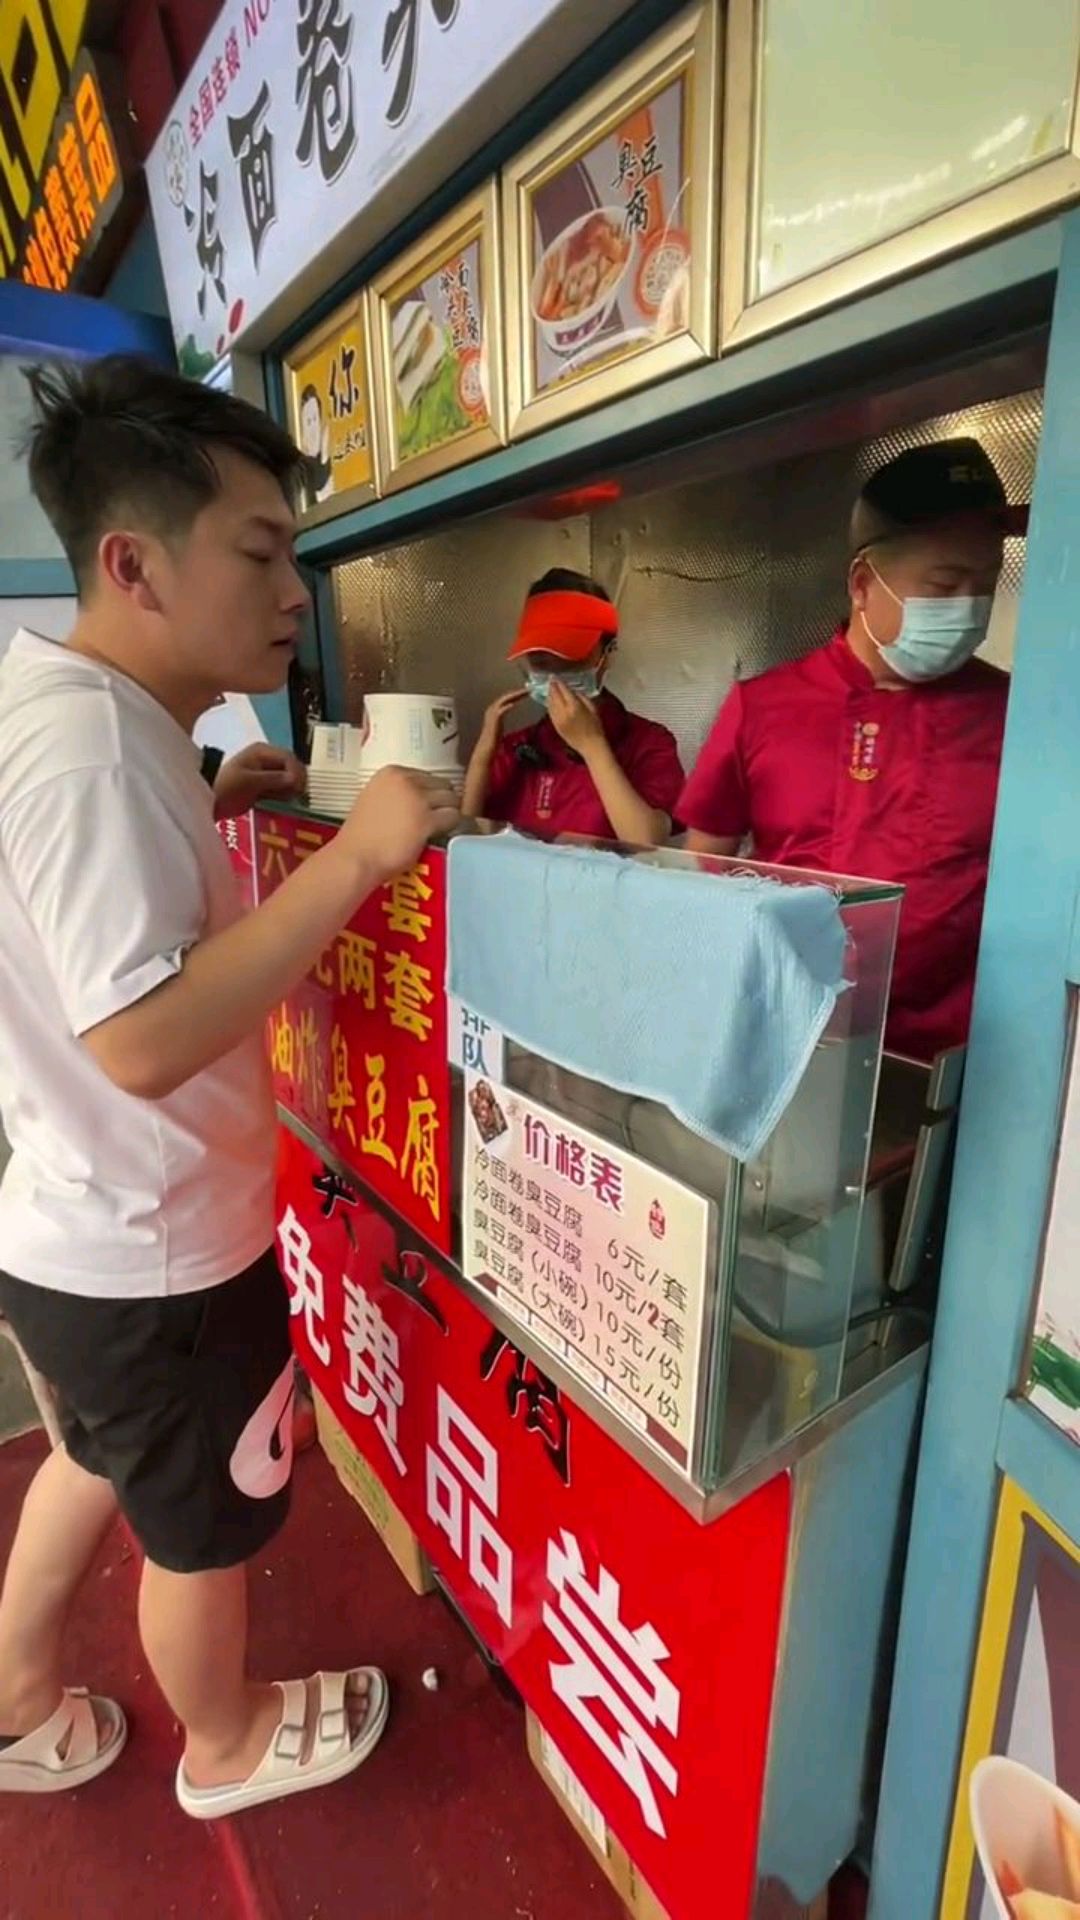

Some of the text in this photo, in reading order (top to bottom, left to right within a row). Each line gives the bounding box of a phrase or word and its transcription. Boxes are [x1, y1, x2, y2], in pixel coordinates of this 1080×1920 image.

[524, 1114, 622, 1213] 价格表
[474, 1179, 582, 1273] 冷面卷臭豆腐
[595, 1262, 686, 1354] 10元/2套
[475, 1148, 583, 1239] 冷面卷臭豆腐
[608, 1238, 688, 1316] 6元/套
[594, 1334, 680, 1429] 15元/份
[597, 1301, 682, 1391] 10元/份
[276, 1204, 682, 1840] 免费品尝
